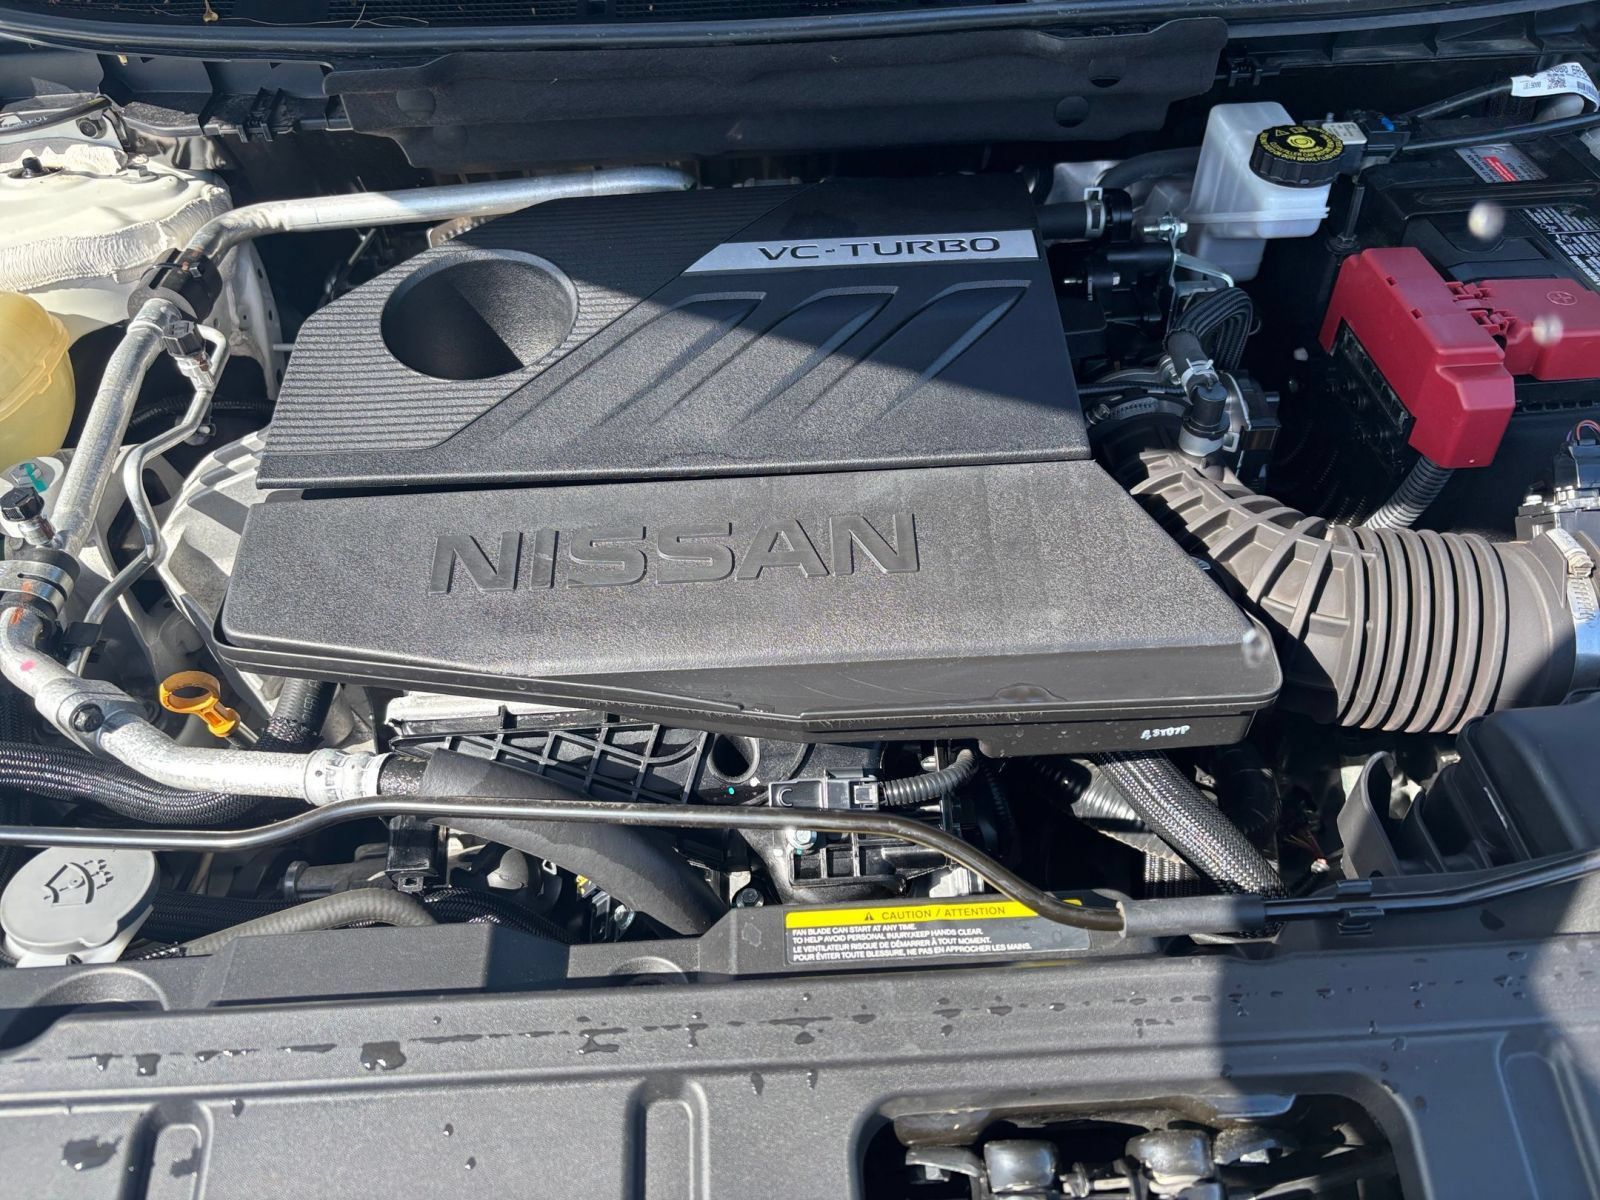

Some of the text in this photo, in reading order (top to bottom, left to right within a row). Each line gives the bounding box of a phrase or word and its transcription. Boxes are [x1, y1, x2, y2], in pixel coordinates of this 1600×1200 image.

[428, 512, 919, 594] NISSAN
[882, 910, 929, 920] CAUTION
[945, 906, 1005, 917] ATTENTION
[810, 928, 831, 936] BLADE
[850, 925, 870, 933] START
[824, 935, 846, 943] AVOID
[848, 933, 885, 942] PERSONAL
[931, 929, 956, 937] HANDS
[958, 927, 983, 936] CLEAR.
[793, 954, 814, 962] POUR
[816, 951, 840, 961] ÉVITER
[842, 951, 865, 959] TOUTE
[866, 949, 905, 958] BLESSURE,
[946, 944, 991, 953] APPROCHER
[1008, 942, 1032, 950] MAINS.
[804, 943, 849, 953] VENTILATEUR
[851, 942, 877, 950] RISQUE
[892, 938, 930, 948] DÉMARRER
[932, 937, 937, 946] À
[938, 937, 956, 945] TOUT
[958, 935, 991, 944] MOMENT.
